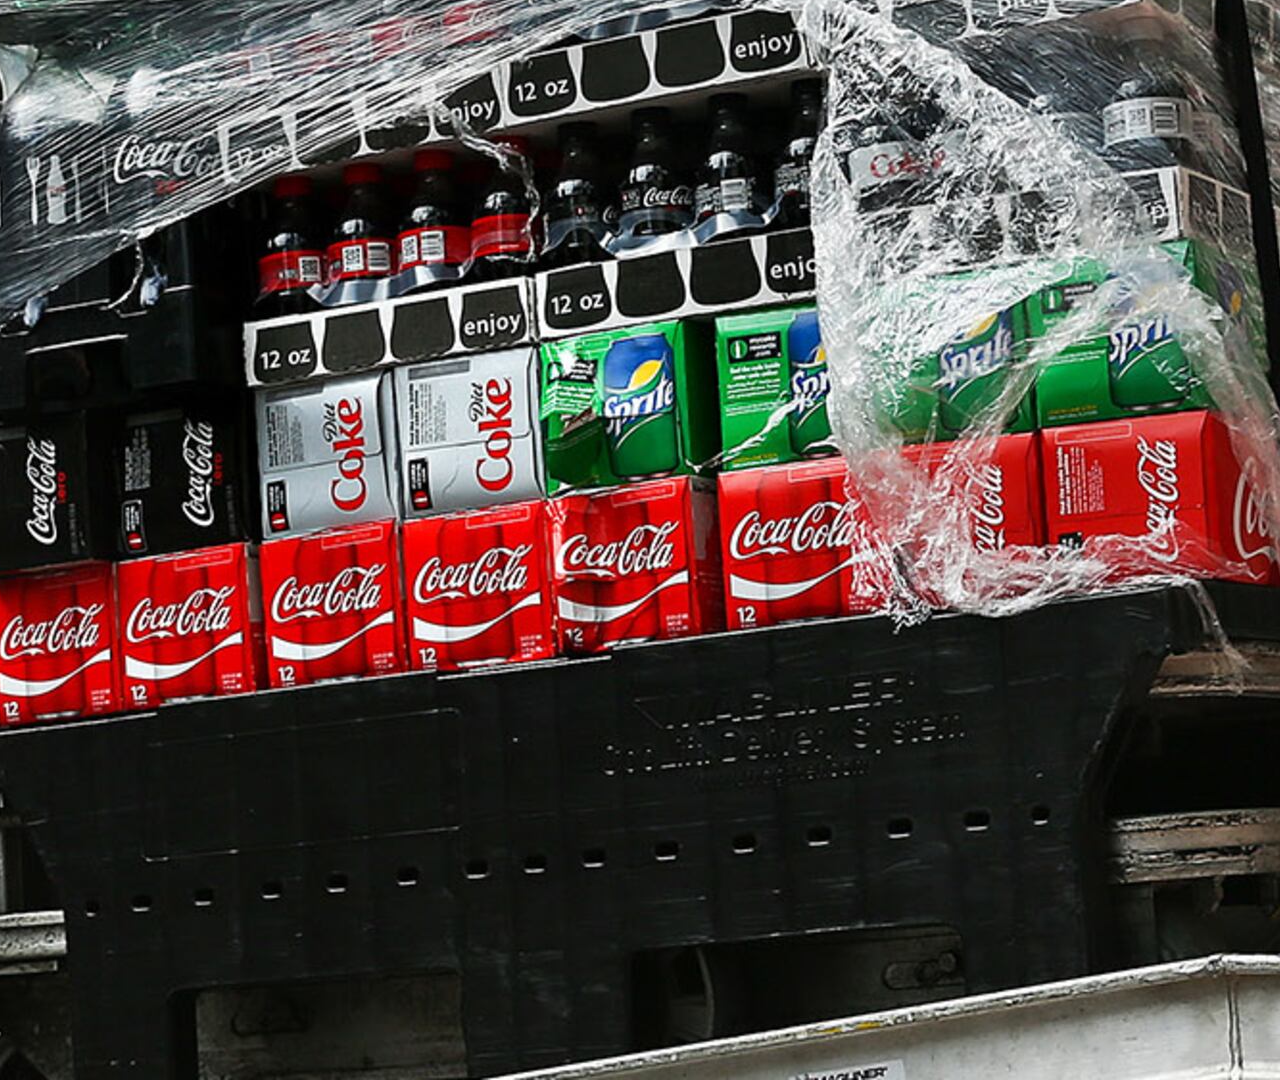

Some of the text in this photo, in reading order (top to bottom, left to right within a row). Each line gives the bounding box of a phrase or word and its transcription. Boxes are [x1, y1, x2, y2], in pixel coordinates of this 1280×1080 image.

[734, 31, 795, 60] enjoy
[515, 79, 569, 102] 12 oz
[113, 133, 222, 184] Coca-Co
[770, 255, 817, 280] enjo
[463, 311, 522, 336] enjoy
[551, 293, 605, 315] 12 oz
[260, 348, 312, 369] 12 oz
[1109, 315, 1173, 365] Spri
[323, 403, 337, 443] Diet
[469, 381, 484, 423] Diet
[604, 373, 674, 436] Sprite
[331, 398, 367, 512] Coke
[476, 378, 514, 492] Coke
[26, 435, 58, 544] Coca-Cola
[181, 418, 215, 527] Coca-Cola
[965, 460, 1005, 555] ca-Cola
[1136, 436, 1179, 563] Coca-Cola
[555, 520, 680, 577] Coca-Cola
[730, 501, 860, 560] Coca-Cola
[271, 563, 386, 624] Coca-Cola
[413, 544, 533, 604] Coca-Cola
[126, 585, 237, 644] Coca-Cola
[736, 606, 756, 623] 12
[278, 667, 296, 682] 12
[419, 648, 437, 665] 12
[2, 702, 19, 717] 12
[130, 684, 147, 701] 12
